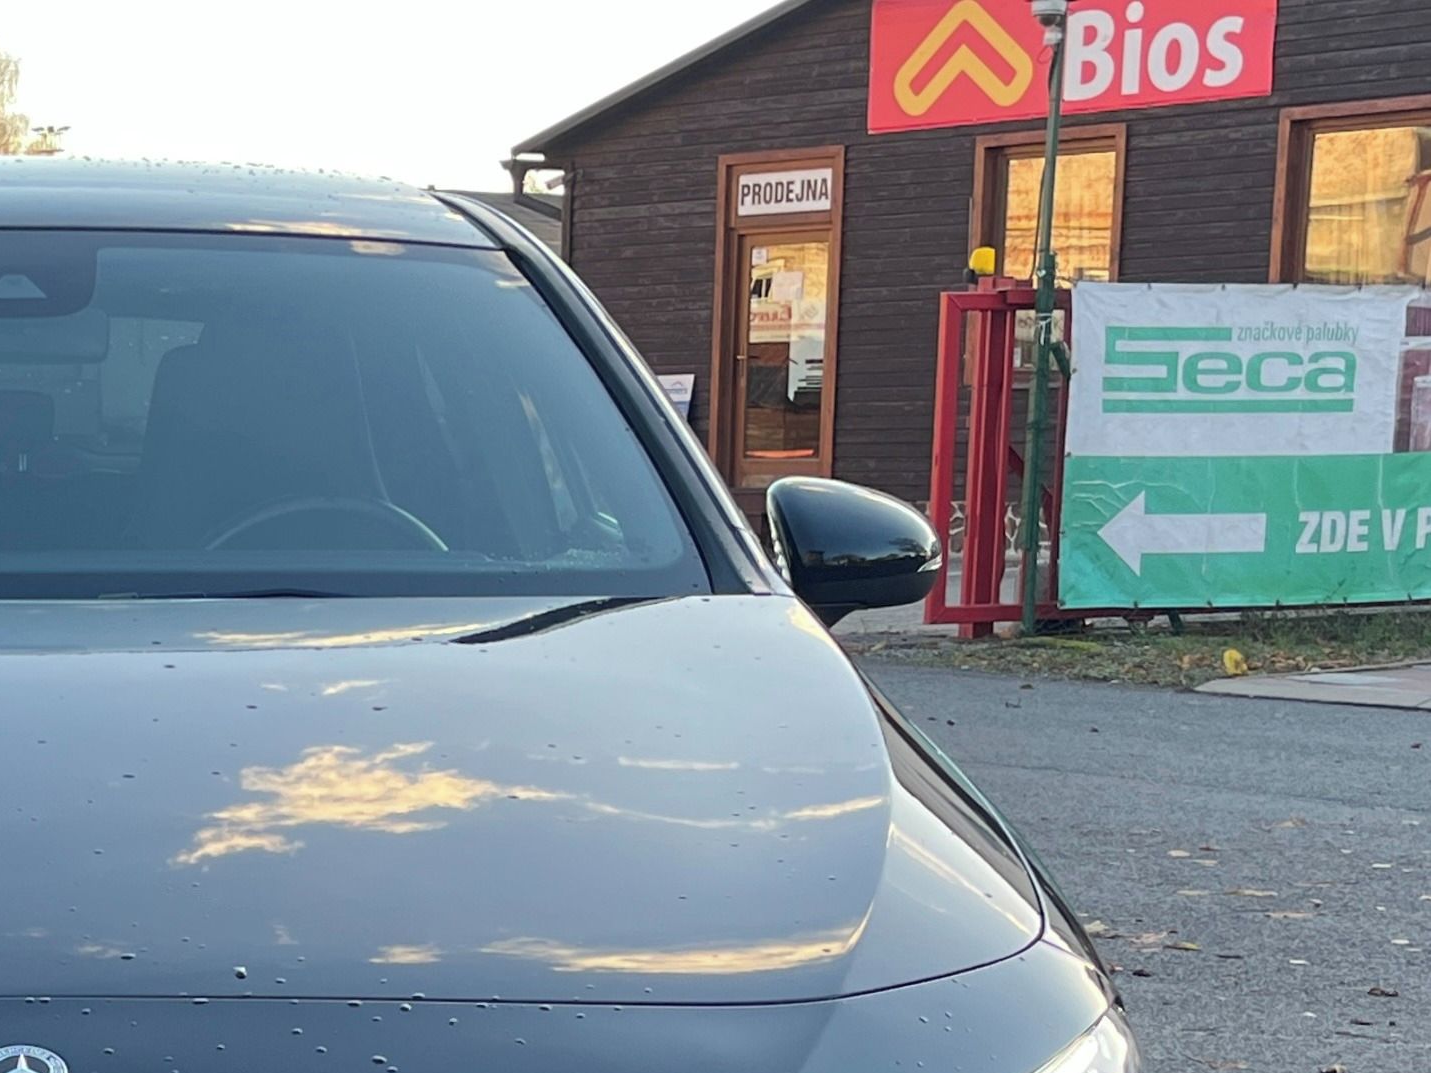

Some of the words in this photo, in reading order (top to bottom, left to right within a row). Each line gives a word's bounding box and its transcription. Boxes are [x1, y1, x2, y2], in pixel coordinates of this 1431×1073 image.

[1063, 1, 1244, 101] Bios
[740, 177, 829, 206] PRODEJNA
[1236, 320, 1303, 342] značkové
[1306, 320, 1360, 347] palubky
[1102, 326, 1357, 394] Seca
[1296, 509, 1371, 554] ZDE
[1381, 508, 1407, 551] V
